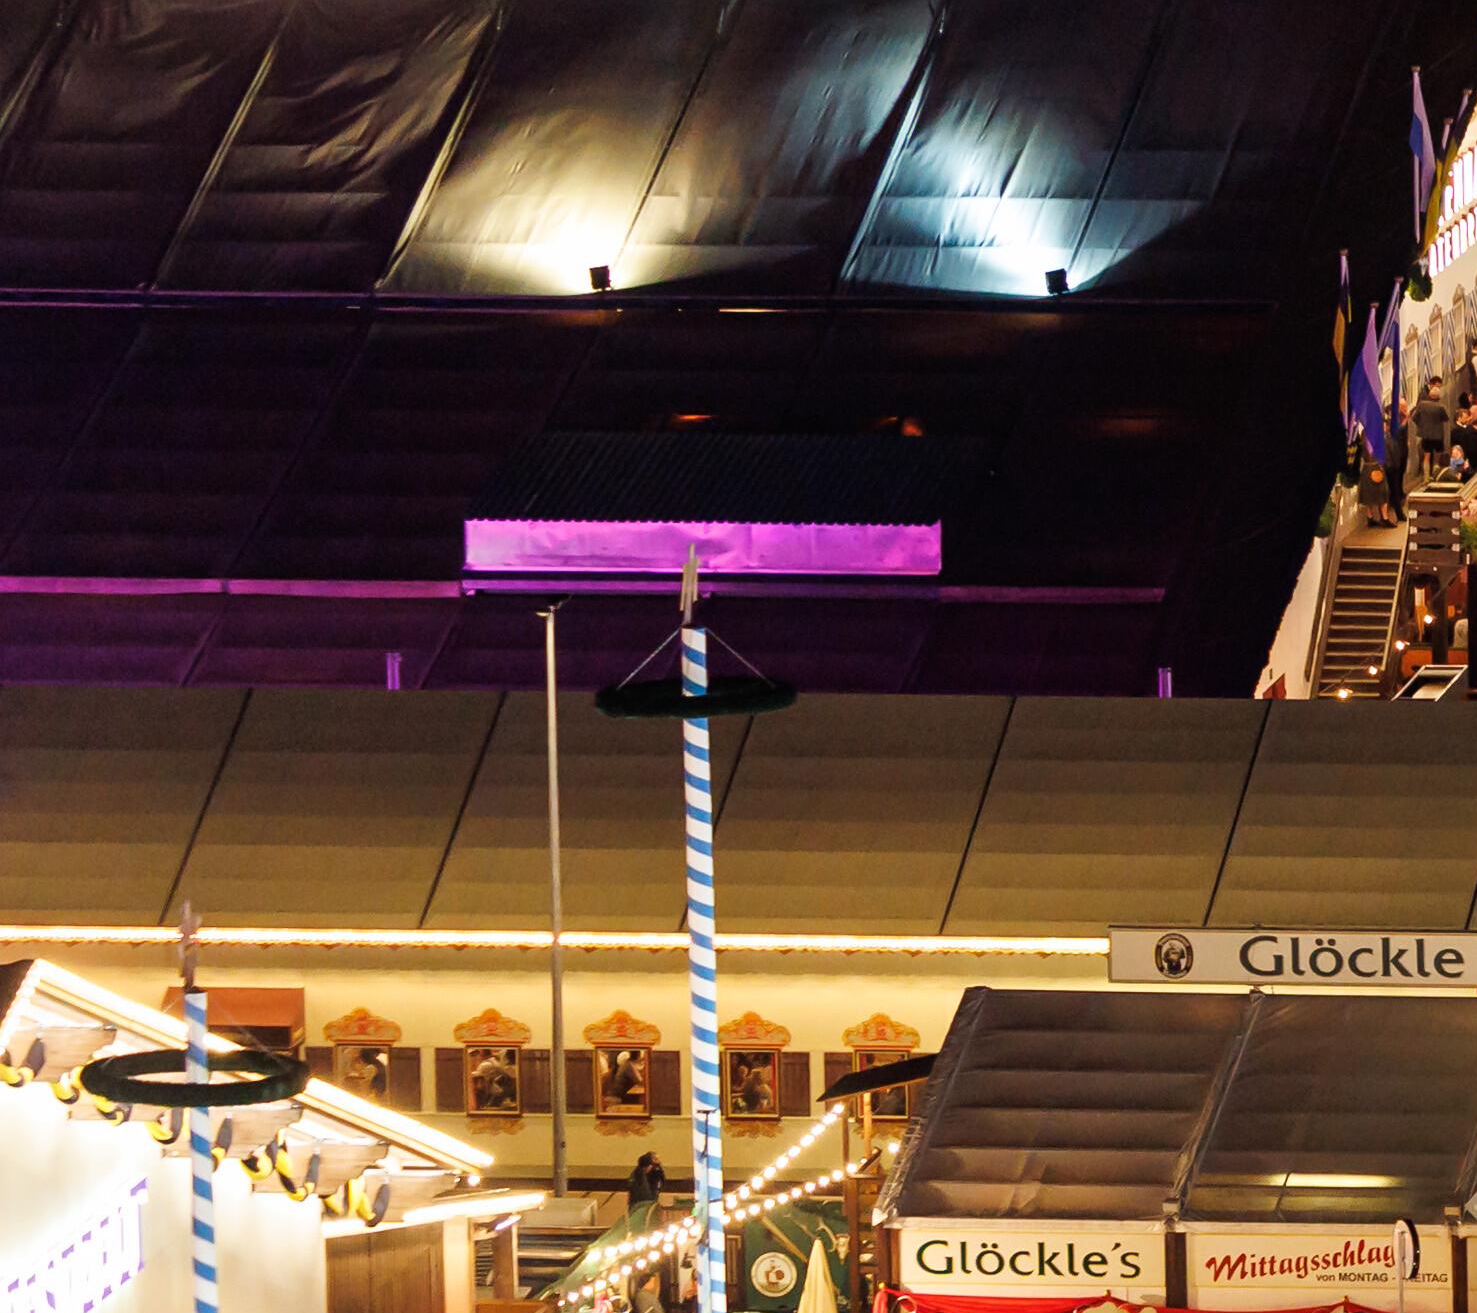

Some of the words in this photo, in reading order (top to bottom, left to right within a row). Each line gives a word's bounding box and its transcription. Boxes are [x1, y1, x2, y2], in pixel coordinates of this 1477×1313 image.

[1238, 934, 1465, 980] Glöckle
[916, 1239, 1142, 1281] Glöckle's
[1316, 1273, 1336, 1283] von
[1338, 1272, 1389, 1283] MONTAG
